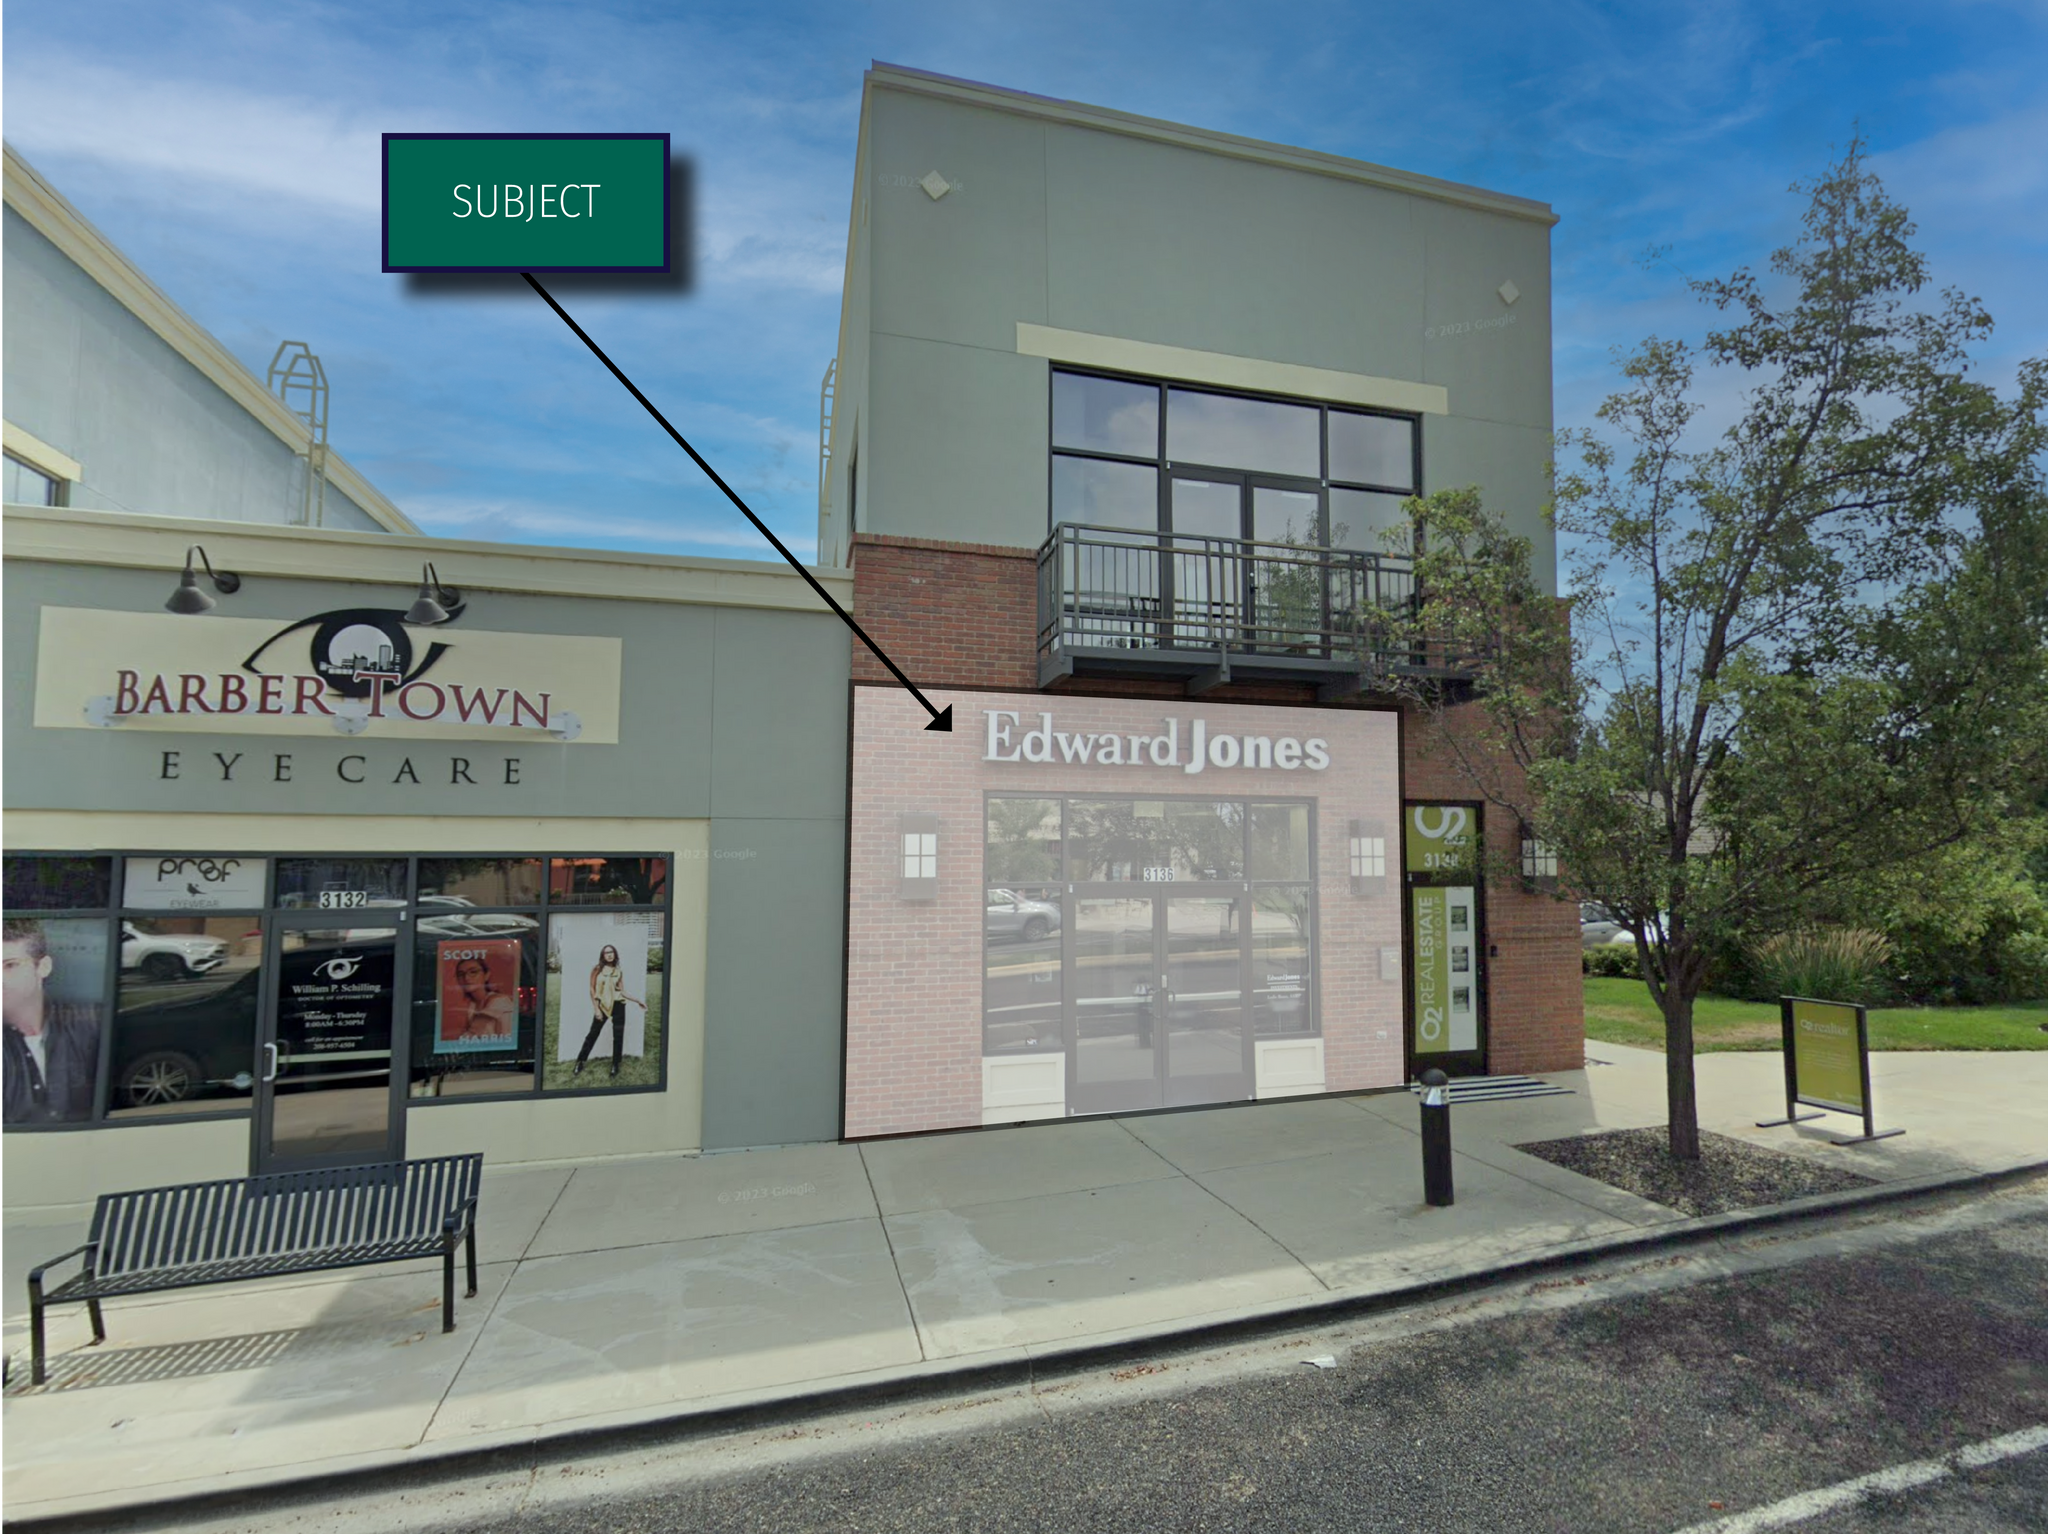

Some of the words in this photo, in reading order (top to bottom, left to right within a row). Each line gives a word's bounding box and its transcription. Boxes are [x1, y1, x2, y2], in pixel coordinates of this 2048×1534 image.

[114, 670, 336, 716] BARBER
[353, 671, 551, 729] TOWN
[982, 710, 1181, 766] Edward
[1184, 719, 1331, 774] Jones
[160, 751, 292, 782] EYE
[336, 755, 521, 785] CARE
[1144, 867, 1174, 881] 3136
[169, 899, 221, 908] EYEWEAR
[321, 891, 365, 908] 3132
[1433, 896, 1443, 949] GROUP
[443, 949, 488, 961] SCOTT
[292, 984, 329, 994] William
[330, 984, 339, 993] P.
[341, 983, 381, 993] Schilling
[458, 1033, 513, 1044] HARRIS
